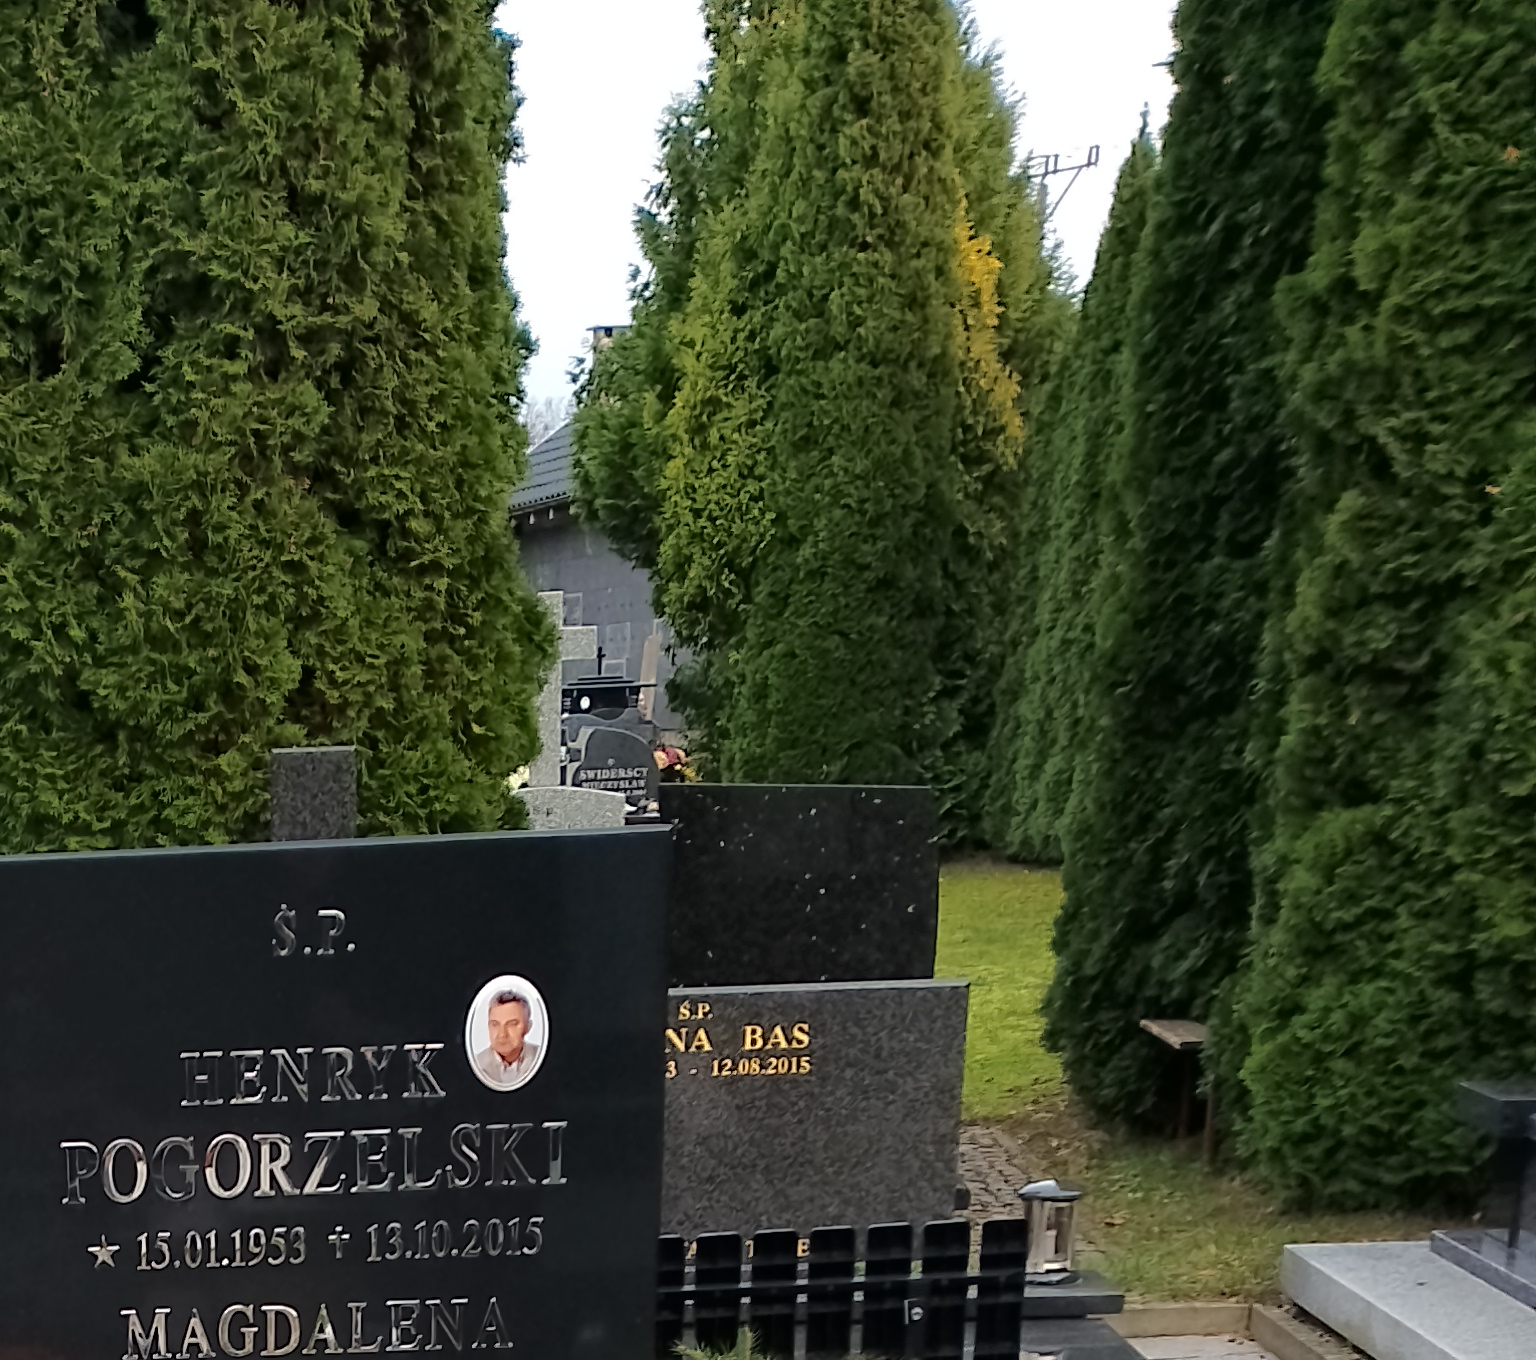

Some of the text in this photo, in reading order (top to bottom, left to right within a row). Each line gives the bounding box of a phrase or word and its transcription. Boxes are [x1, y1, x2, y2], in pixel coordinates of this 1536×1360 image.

[744, 1023, 810, 1051] BAS
[179, 1043, 446, 1107] HENRYK
[711, 1056, 811, 1077] 12.08.2015
[60, 1121, 568, 1205] POGORZELSKI
[135, 1217, 545, 1271] 15.01.1953 13.10.2015
[120, 1297, 514, 1360] MAGDALENA
